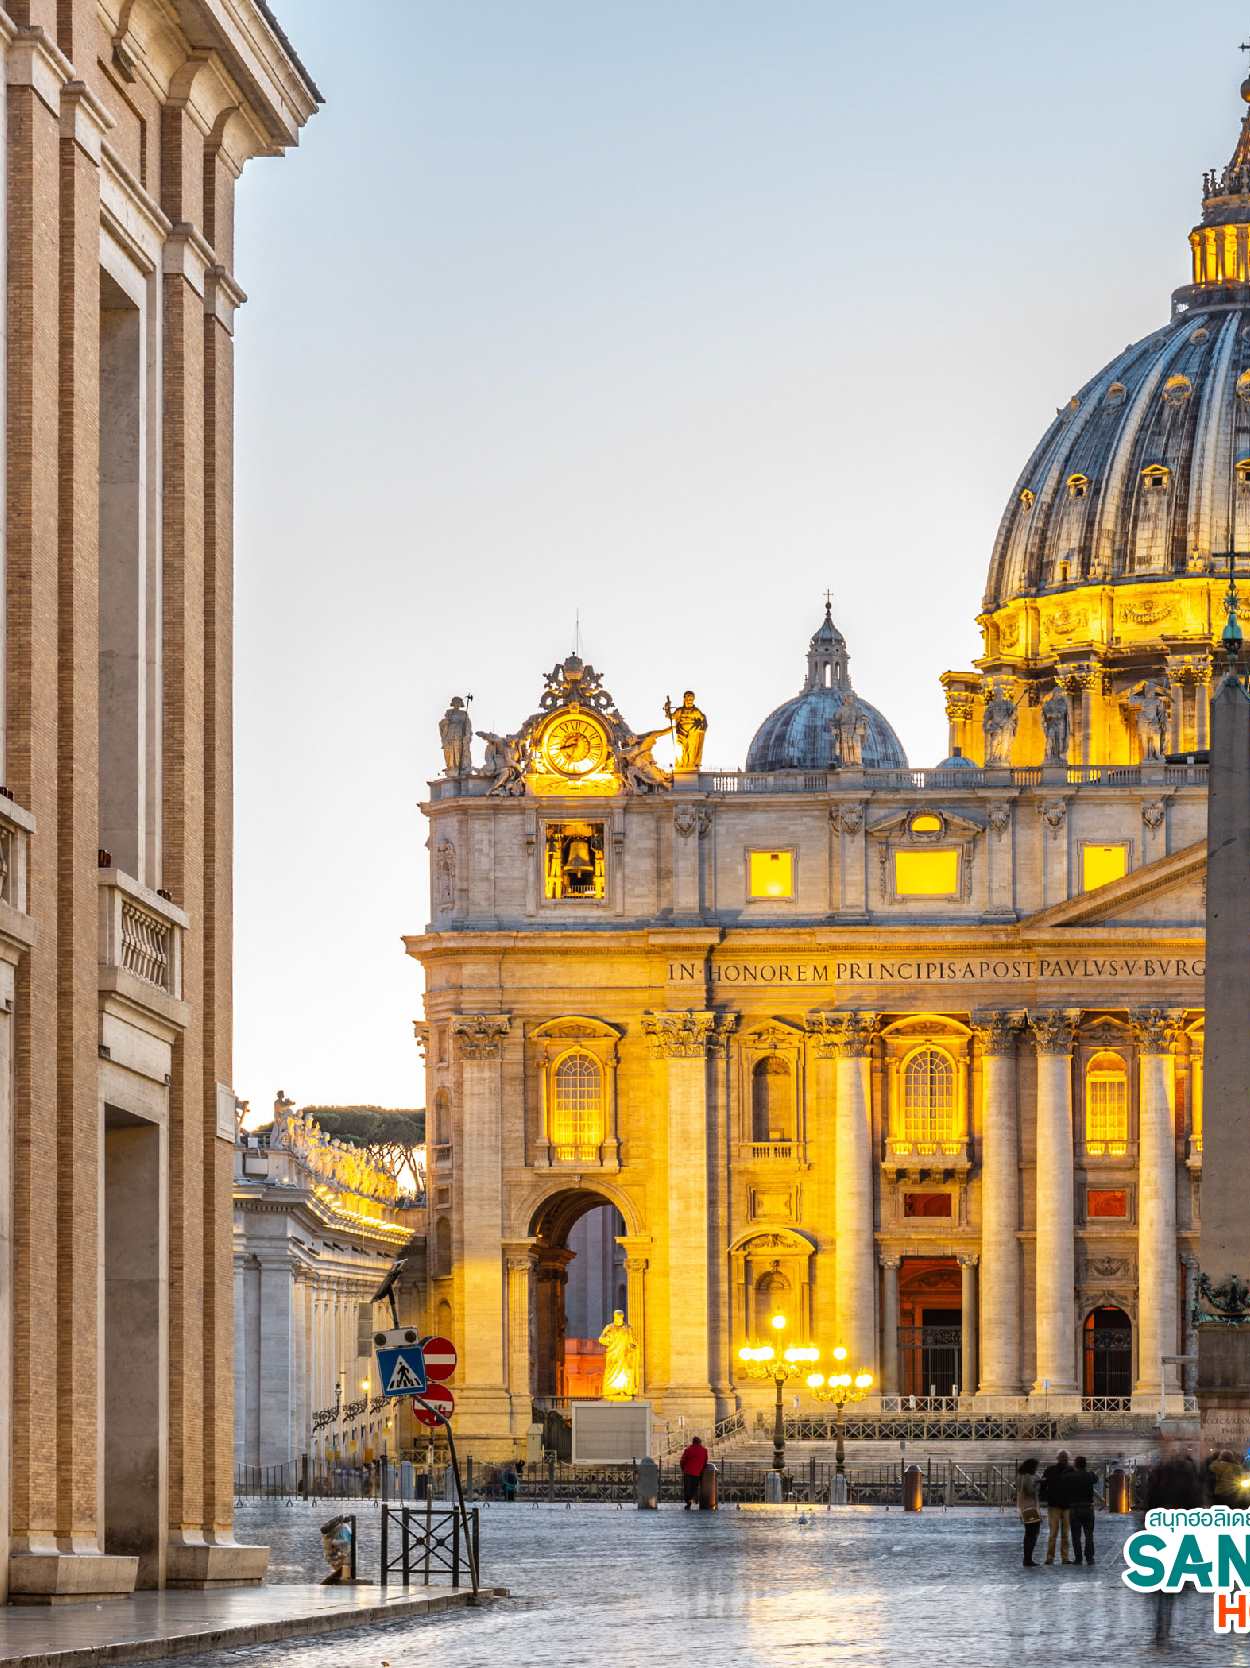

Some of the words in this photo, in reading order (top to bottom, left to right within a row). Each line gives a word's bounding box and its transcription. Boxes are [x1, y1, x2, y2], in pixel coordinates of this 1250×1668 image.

[668, 963, 696, 981] IN
[707, 964, 830, 982] HONOREM
[836, 961, 958, 980] PRINCIPIS
[962, 961, 1036, 979] APOST
[1039, 959, 1118, 977] PAVLVS
[1123, 959, 1139, 976] V
